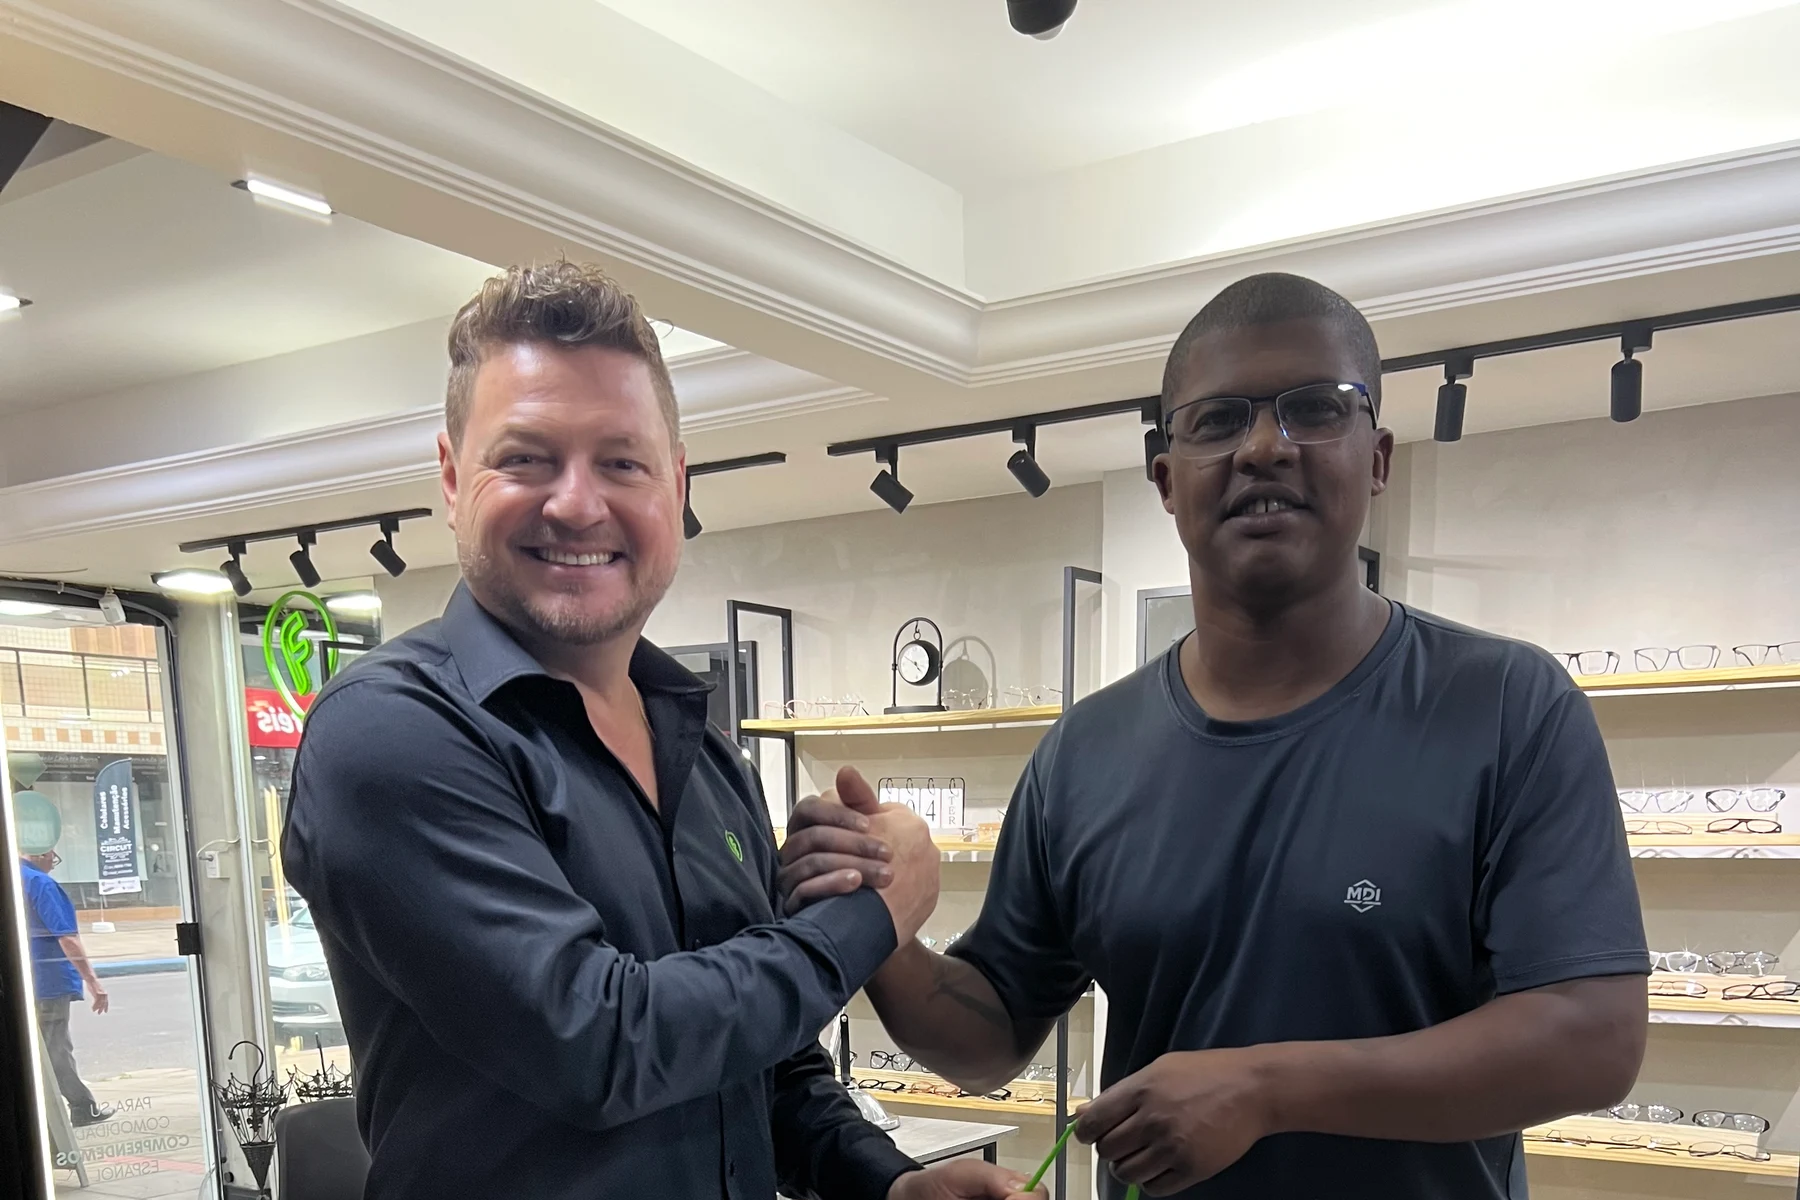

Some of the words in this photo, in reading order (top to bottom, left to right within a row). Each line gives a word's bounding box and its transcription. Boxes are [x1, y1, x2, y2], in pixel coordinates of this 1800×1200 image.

[99, 791, 108, 829] Celulares
[109, 784, 121, 834] Manutenção
[100, 843, 133, 853] CIRCUIT
[1346, 886, 1381, 901] MDI
